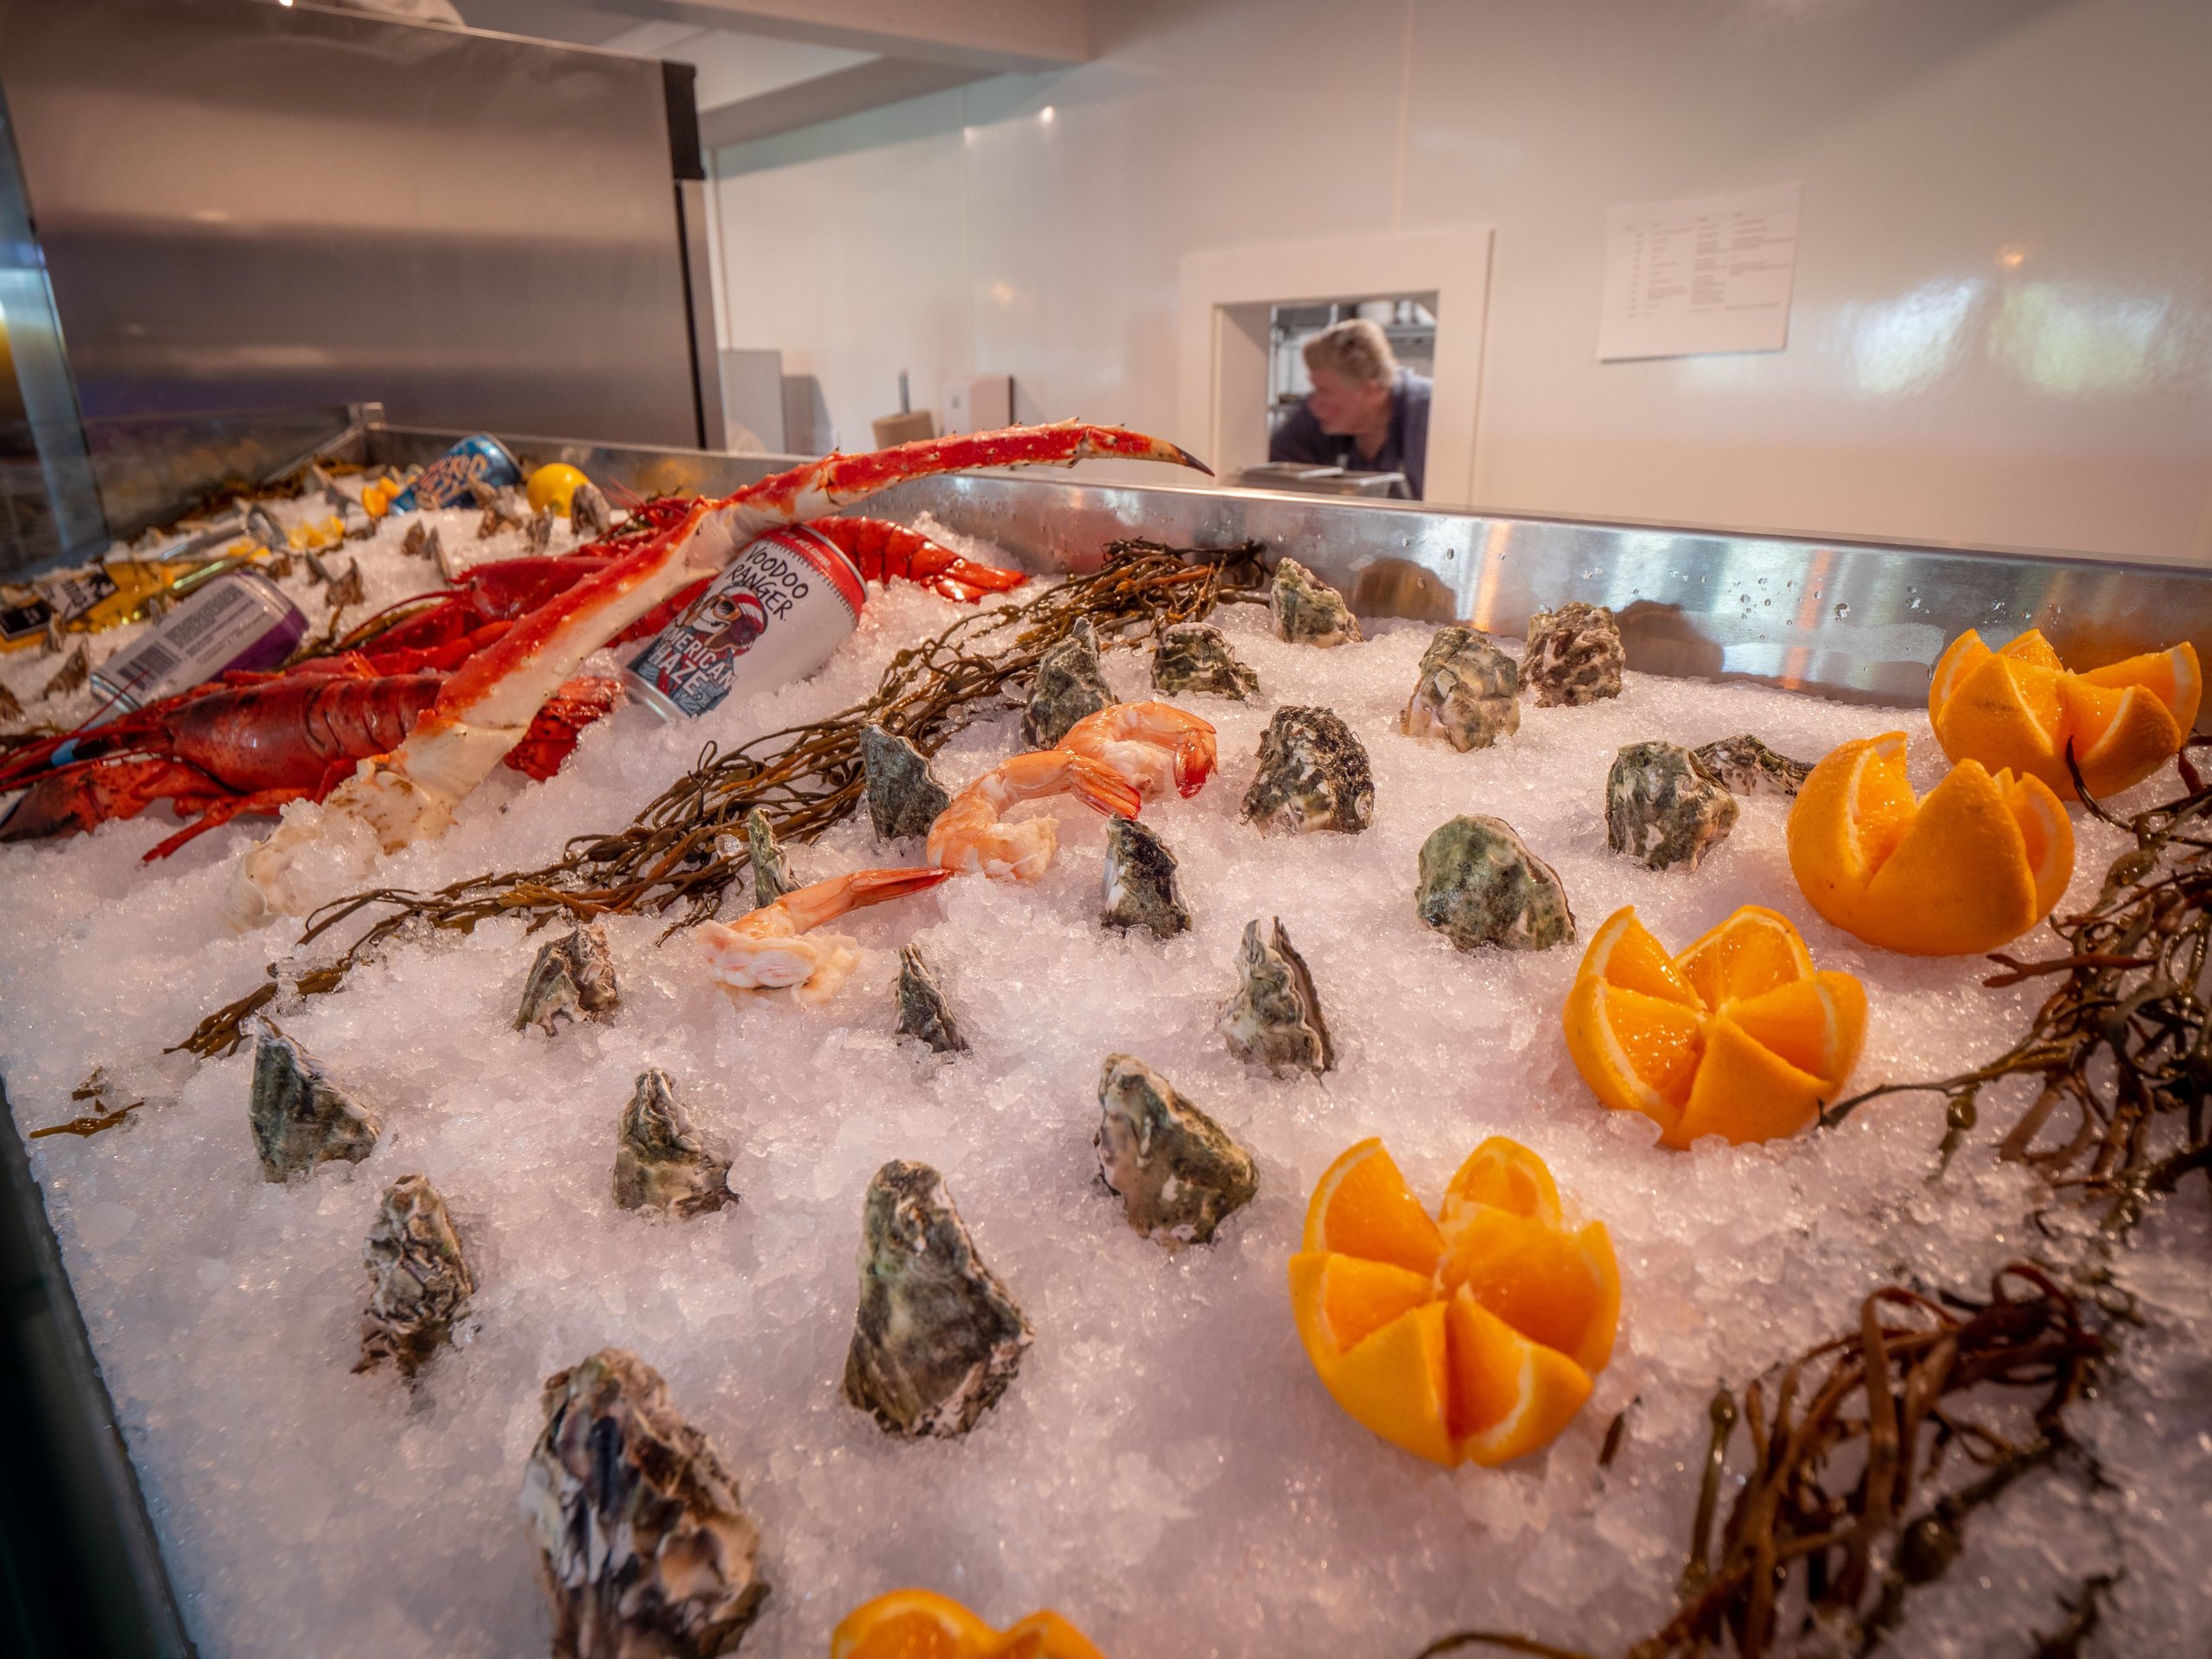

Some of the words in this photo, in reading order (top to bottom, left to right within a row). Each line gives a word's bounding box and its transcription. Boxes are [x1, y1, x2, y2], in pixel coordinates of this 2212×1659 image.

[745, 546, 809, 600] VOODOO
[795, 538, 831, 568] BELGIUM
[648, 645, 710, 696] HAZE
